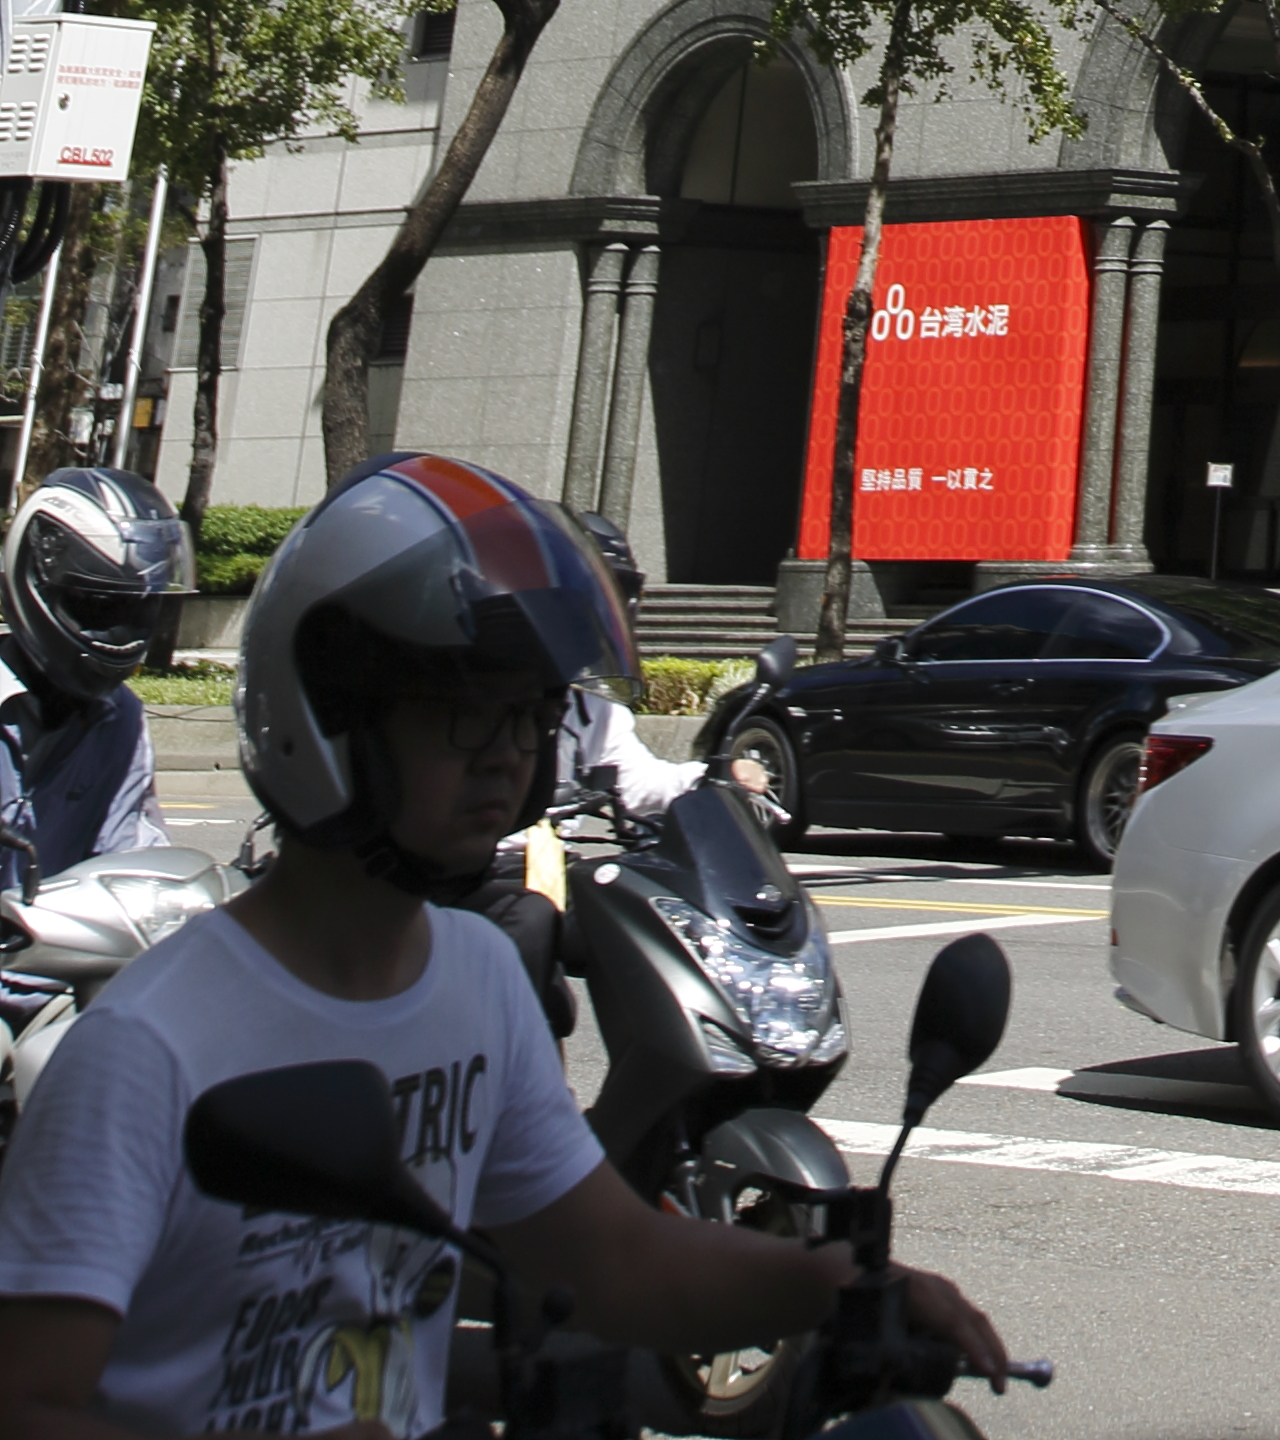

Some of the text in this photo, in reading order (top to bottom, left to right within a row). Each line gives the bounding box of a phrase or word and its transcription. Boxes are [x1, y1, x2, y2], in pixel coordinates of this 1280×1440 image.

[860, 467, 994, 491] 堅持品質 一以貫之
